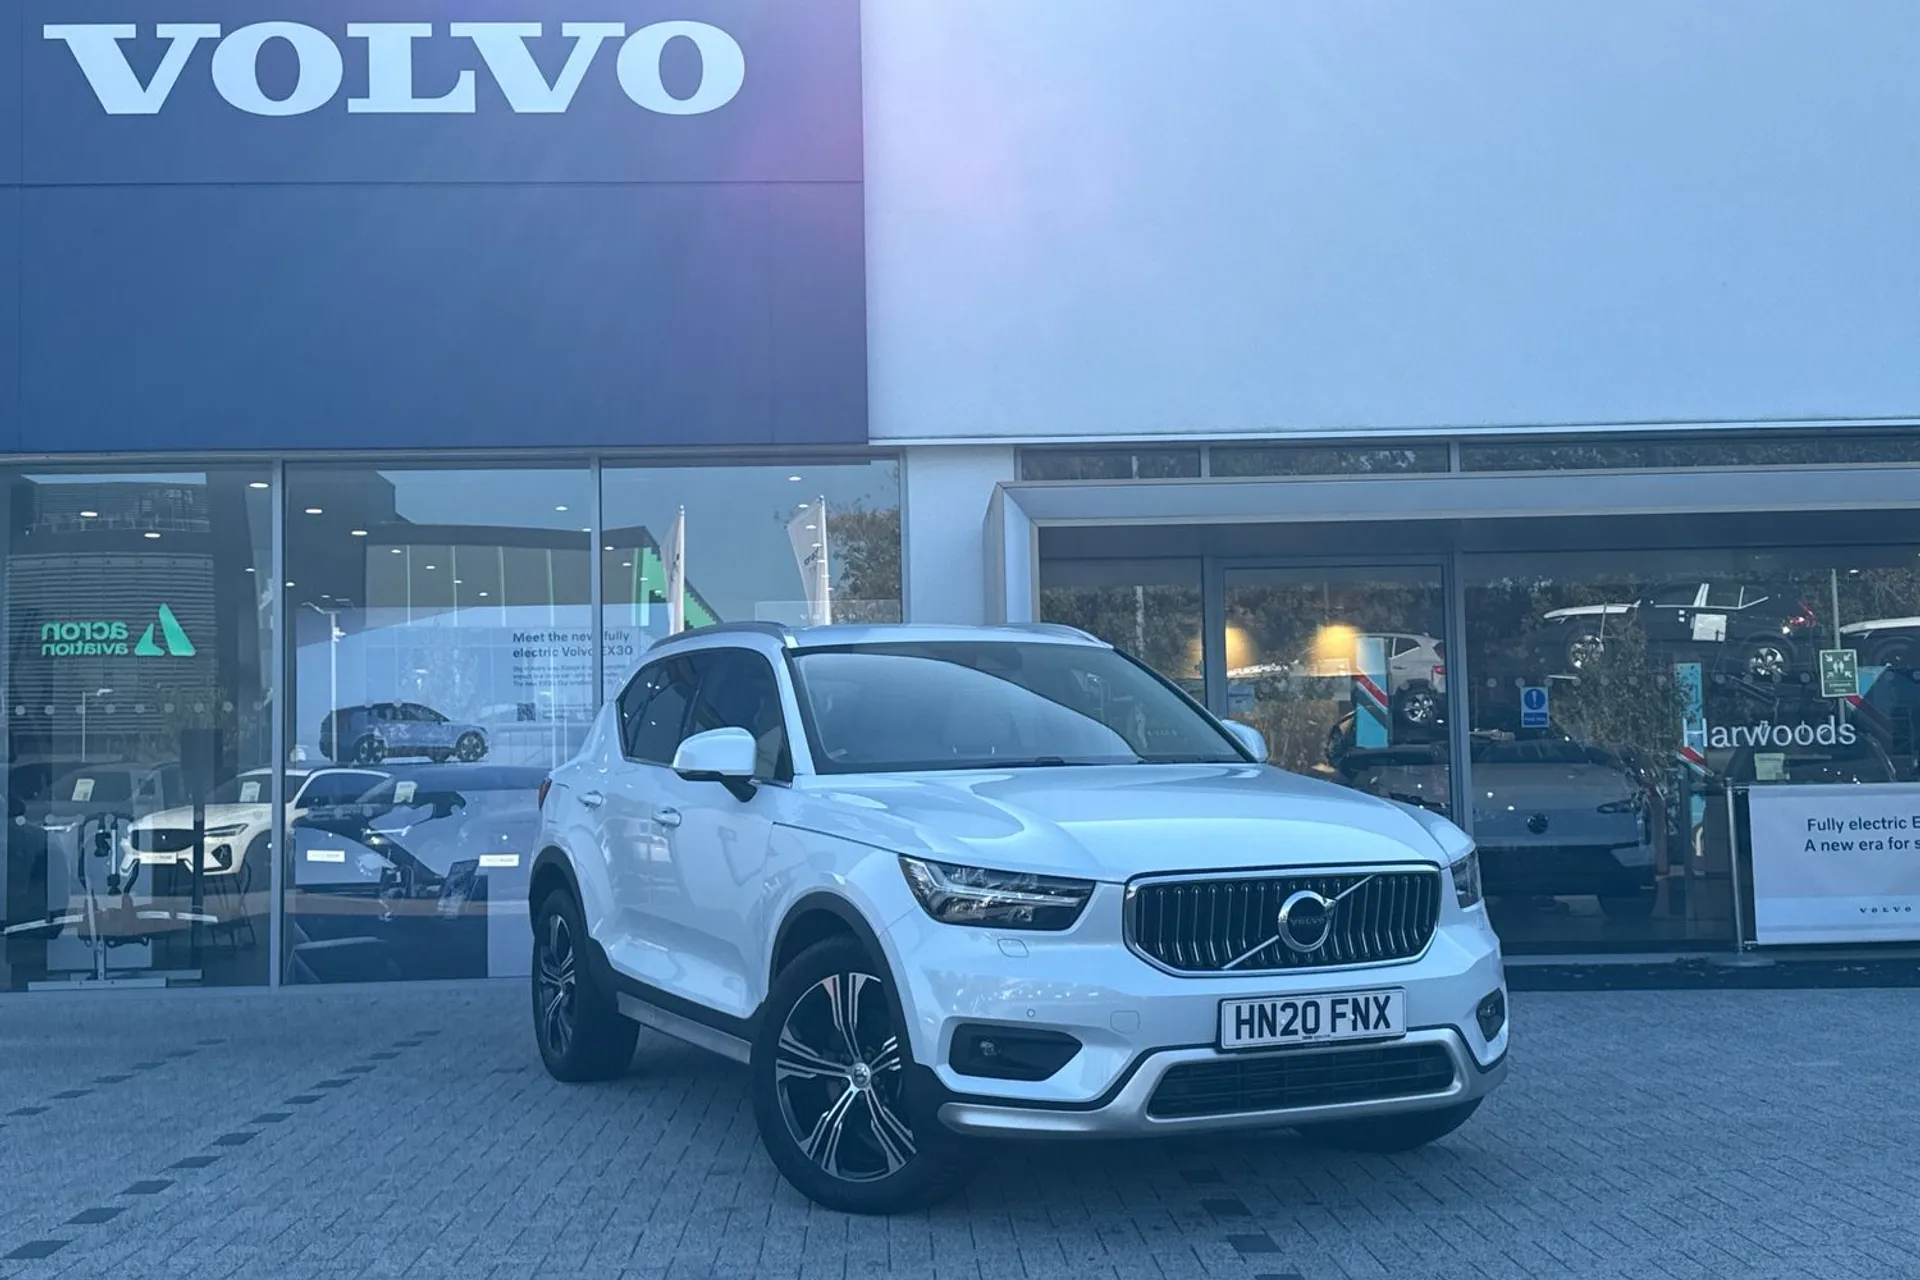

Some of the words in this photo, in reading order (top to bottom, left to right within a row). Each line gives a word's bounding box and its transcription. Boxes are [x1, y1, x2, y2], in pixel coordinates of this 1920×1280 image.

[43, 20, 745, 116] VOLVO
[513, 632, 545, 643] Meet
[548, 631, 568, 642] the
[604, 631, 630, 643] fully
[513, 647, 558, 658] electric
[1682, 715, 1857, 748] Harwoods
[1807, 817, 1844, 834] Fully
[1849, 816, 1907, 830] electric
[1804, 839, 1816, 852] A
[1821, 840, 1854, 851] new
[1859, 839, 1883, 851] era
[1888, 836, 1910, 850] for
[1860, 906, 1911, 914] VOLVO
[1236, 1000, 1320, 1040] HN20
[1331, 995, 1391, 1033] FNX
